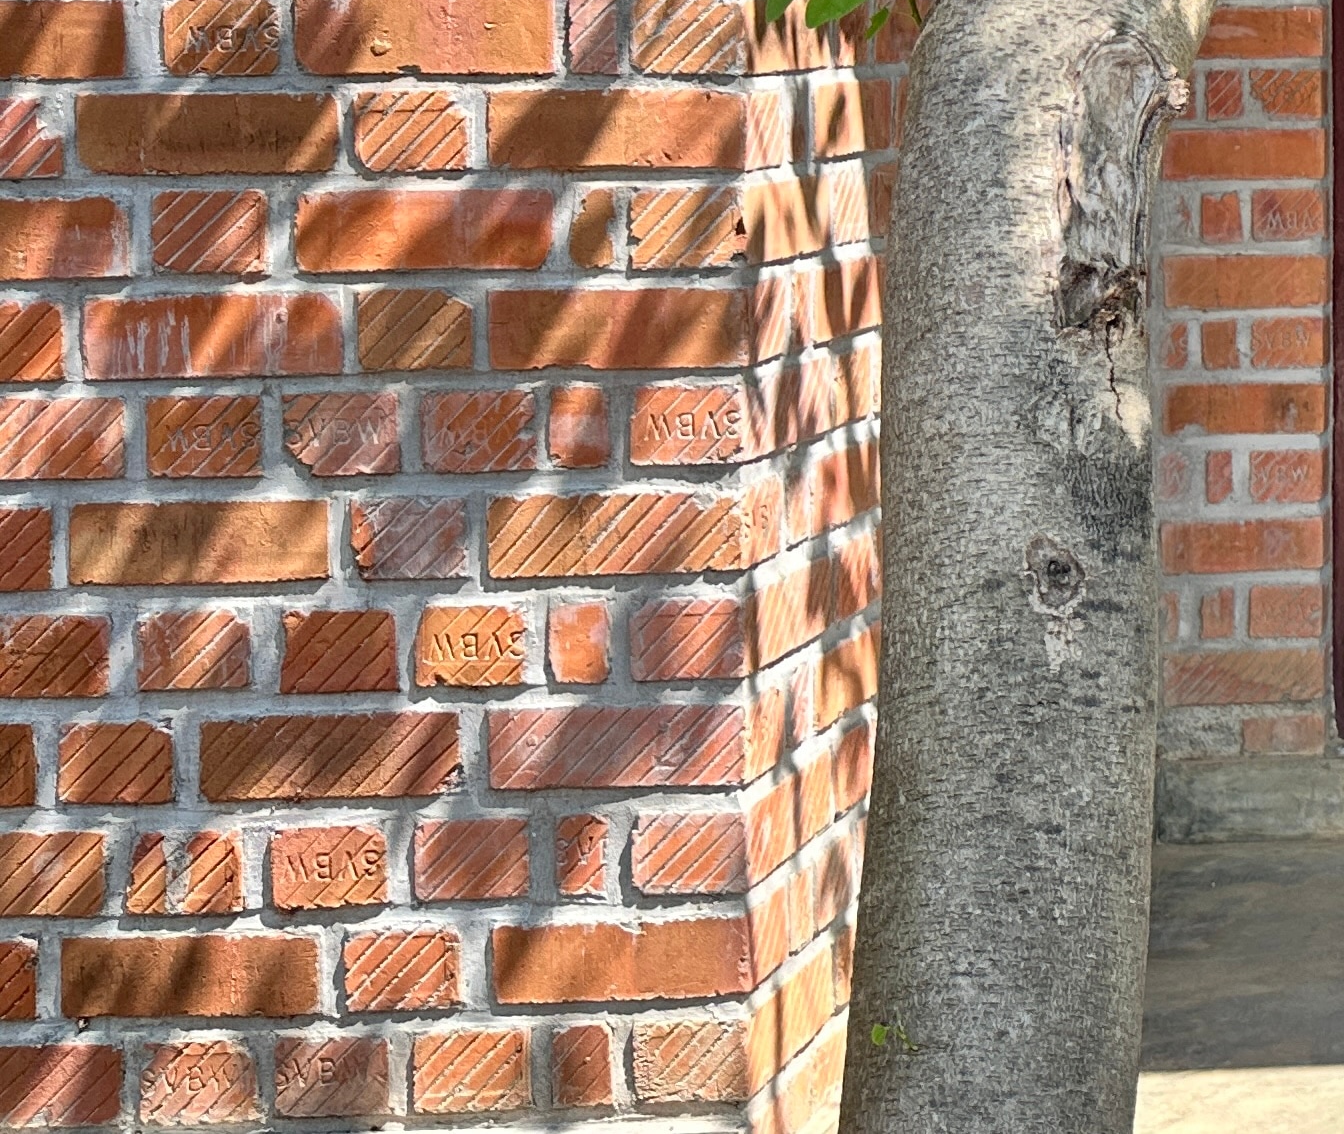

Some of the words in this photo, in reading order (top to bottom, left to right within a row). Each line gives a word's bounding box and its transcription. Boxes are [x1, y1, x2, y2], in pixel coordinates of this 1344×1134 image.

[647, 410, 741, 440] SVBW
[430, 632, 525, 662] SVBW
[287, 852, 387, 881] SVBW
